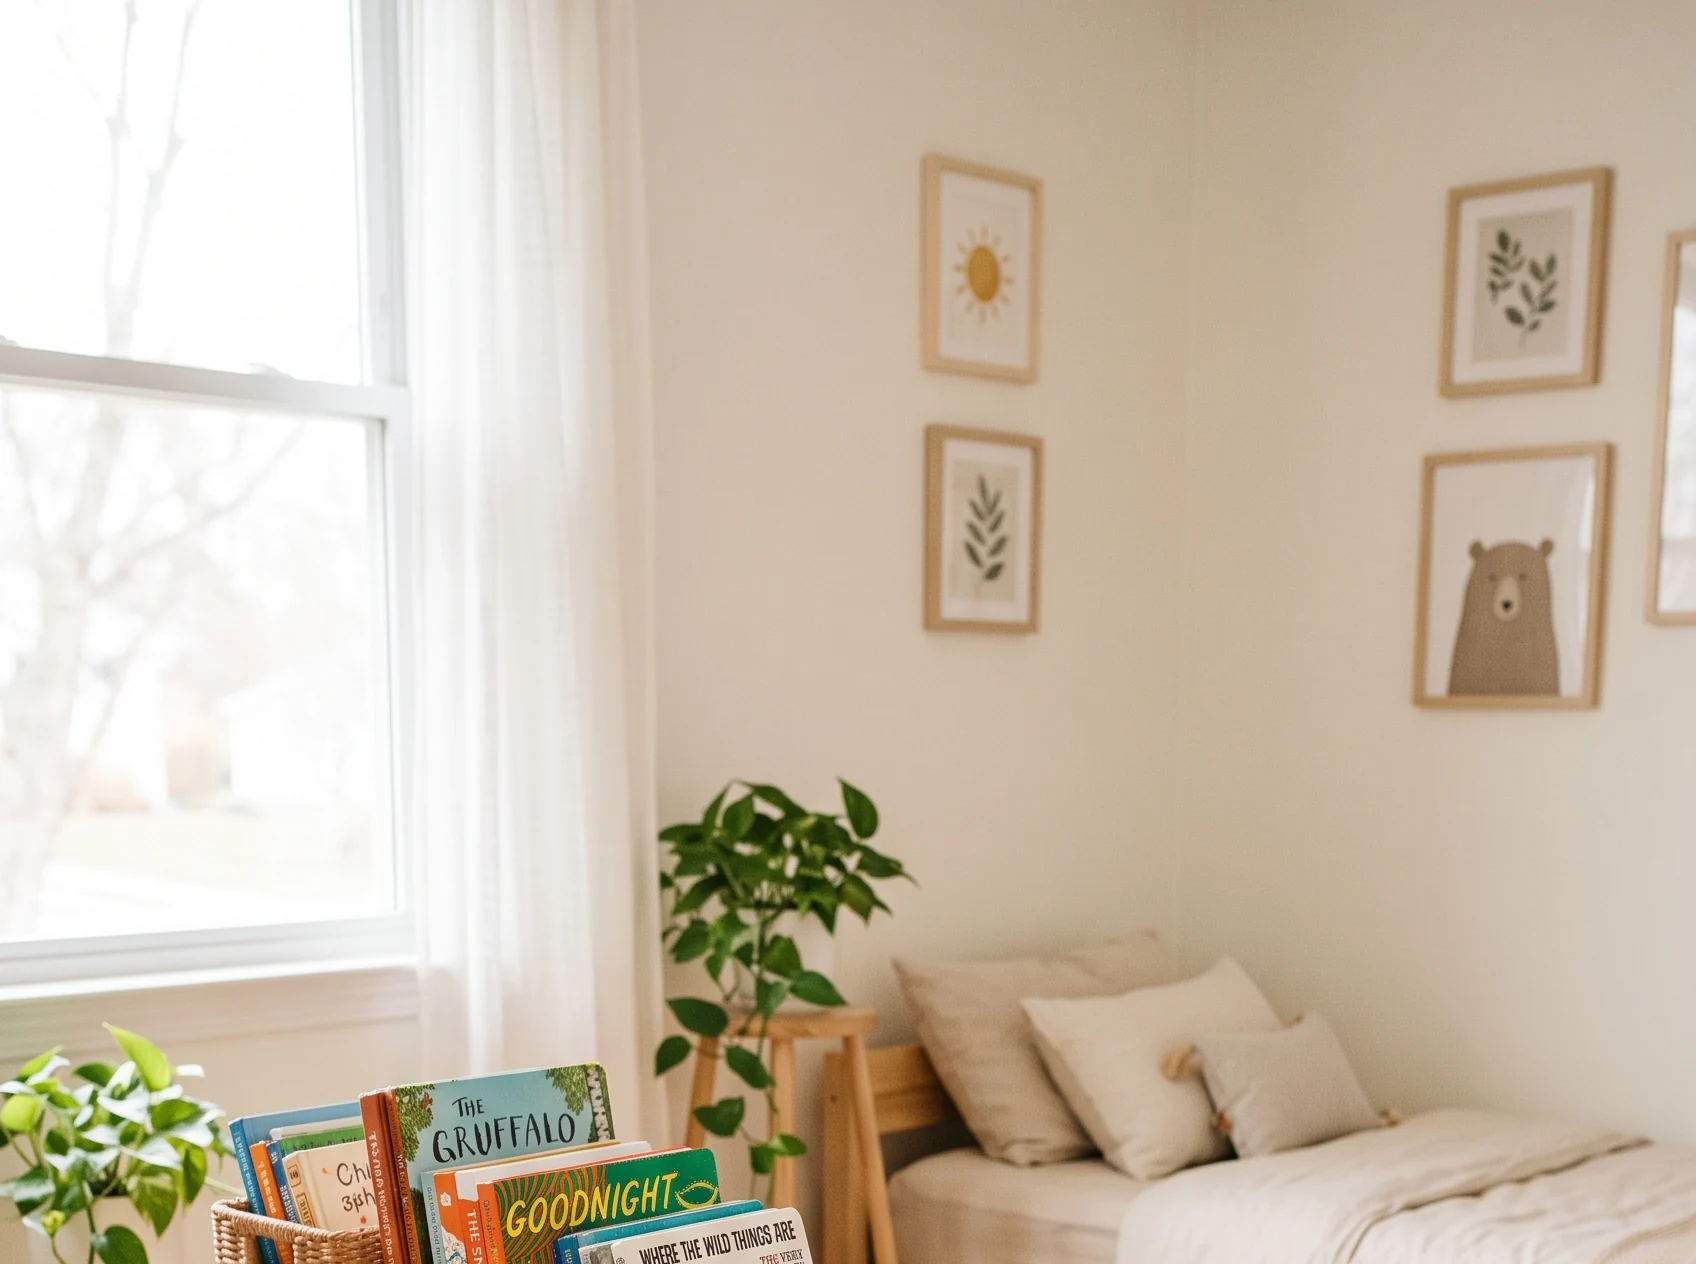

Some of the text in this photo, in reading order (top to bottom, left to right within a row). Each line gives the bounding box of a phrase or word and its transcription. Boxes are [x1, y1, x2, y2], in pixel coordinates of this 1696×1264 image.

[451, 1096, 485, 1118] THE
[432, 1112, 576, 1163] GRUFFALO
[506, 1171, 679, 1237] GOODNIGHT
[467, 1208, 480, 1243] THE
[680, 1238, 702, 1262] THE
[702, 1233, 731, 1257] WILD
[731, 1224, 772, 1252] THINGS
[773, 1220, 797, 1242] ARE
